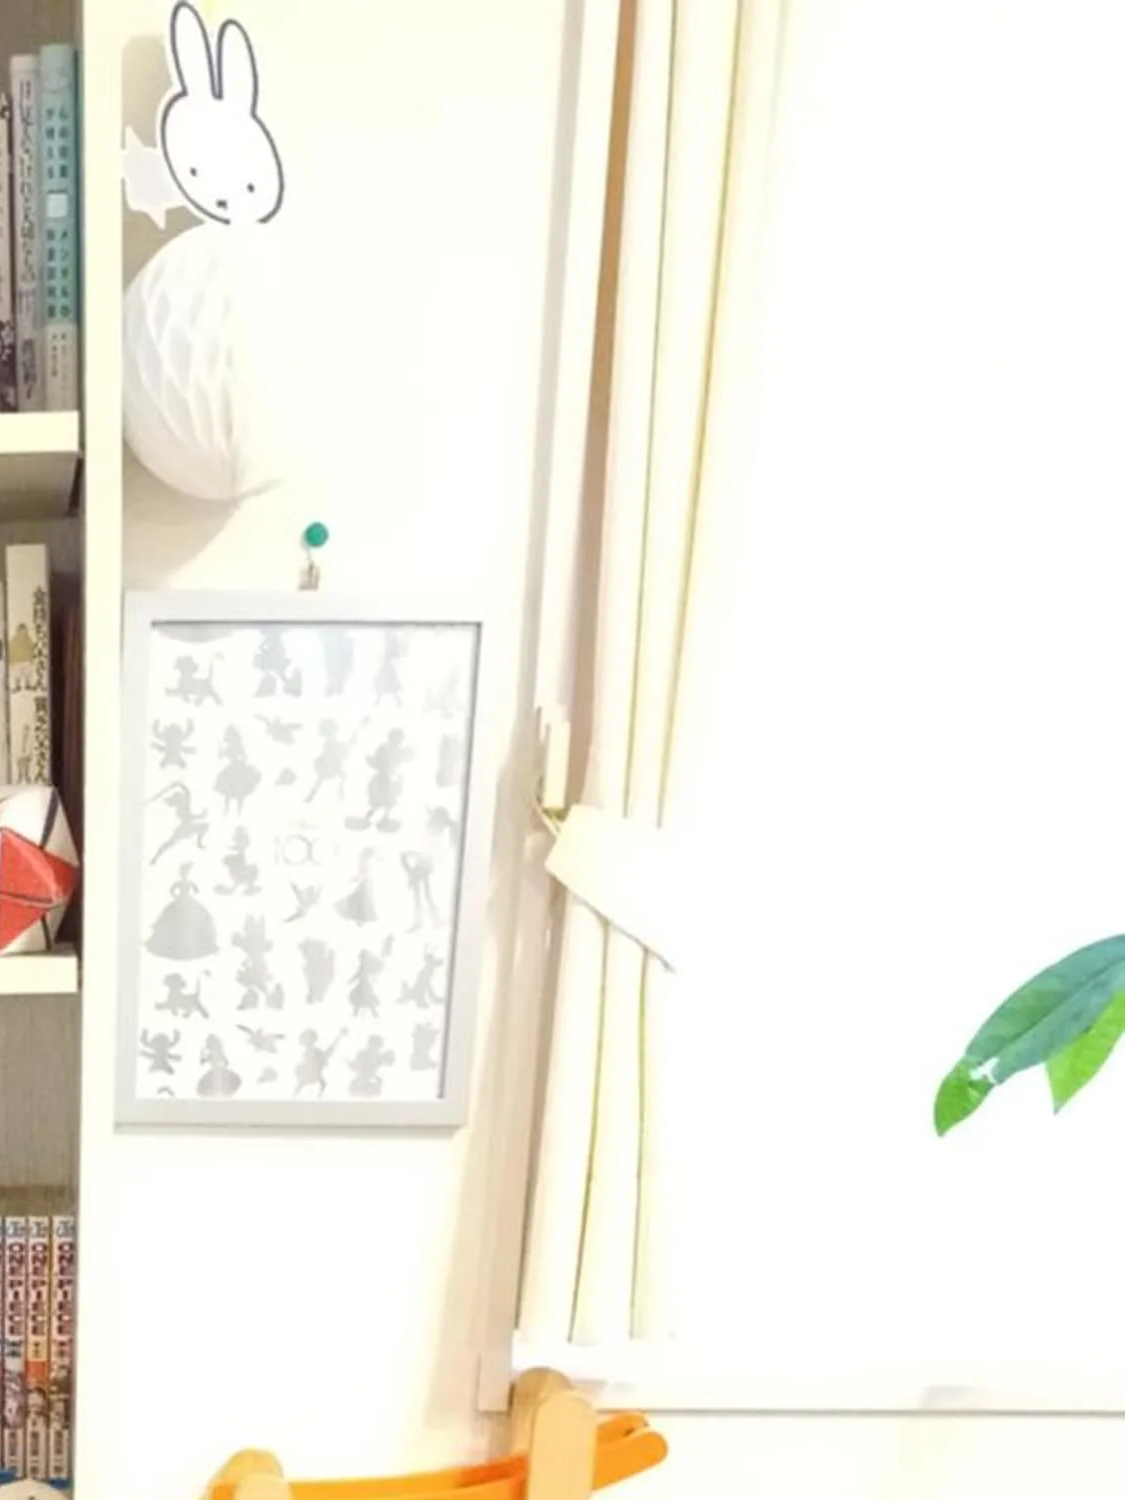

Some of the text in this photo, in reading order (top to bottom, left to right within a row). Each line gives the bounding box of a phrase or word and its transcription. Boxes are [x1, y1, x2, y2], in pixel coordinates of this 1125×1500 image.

[8, 1242, 24, 1335] ONE PIECE
[32, 1242, 47, 1335] ONE PIECE
[57, 1242, 74, 1335] ONE PIECE
